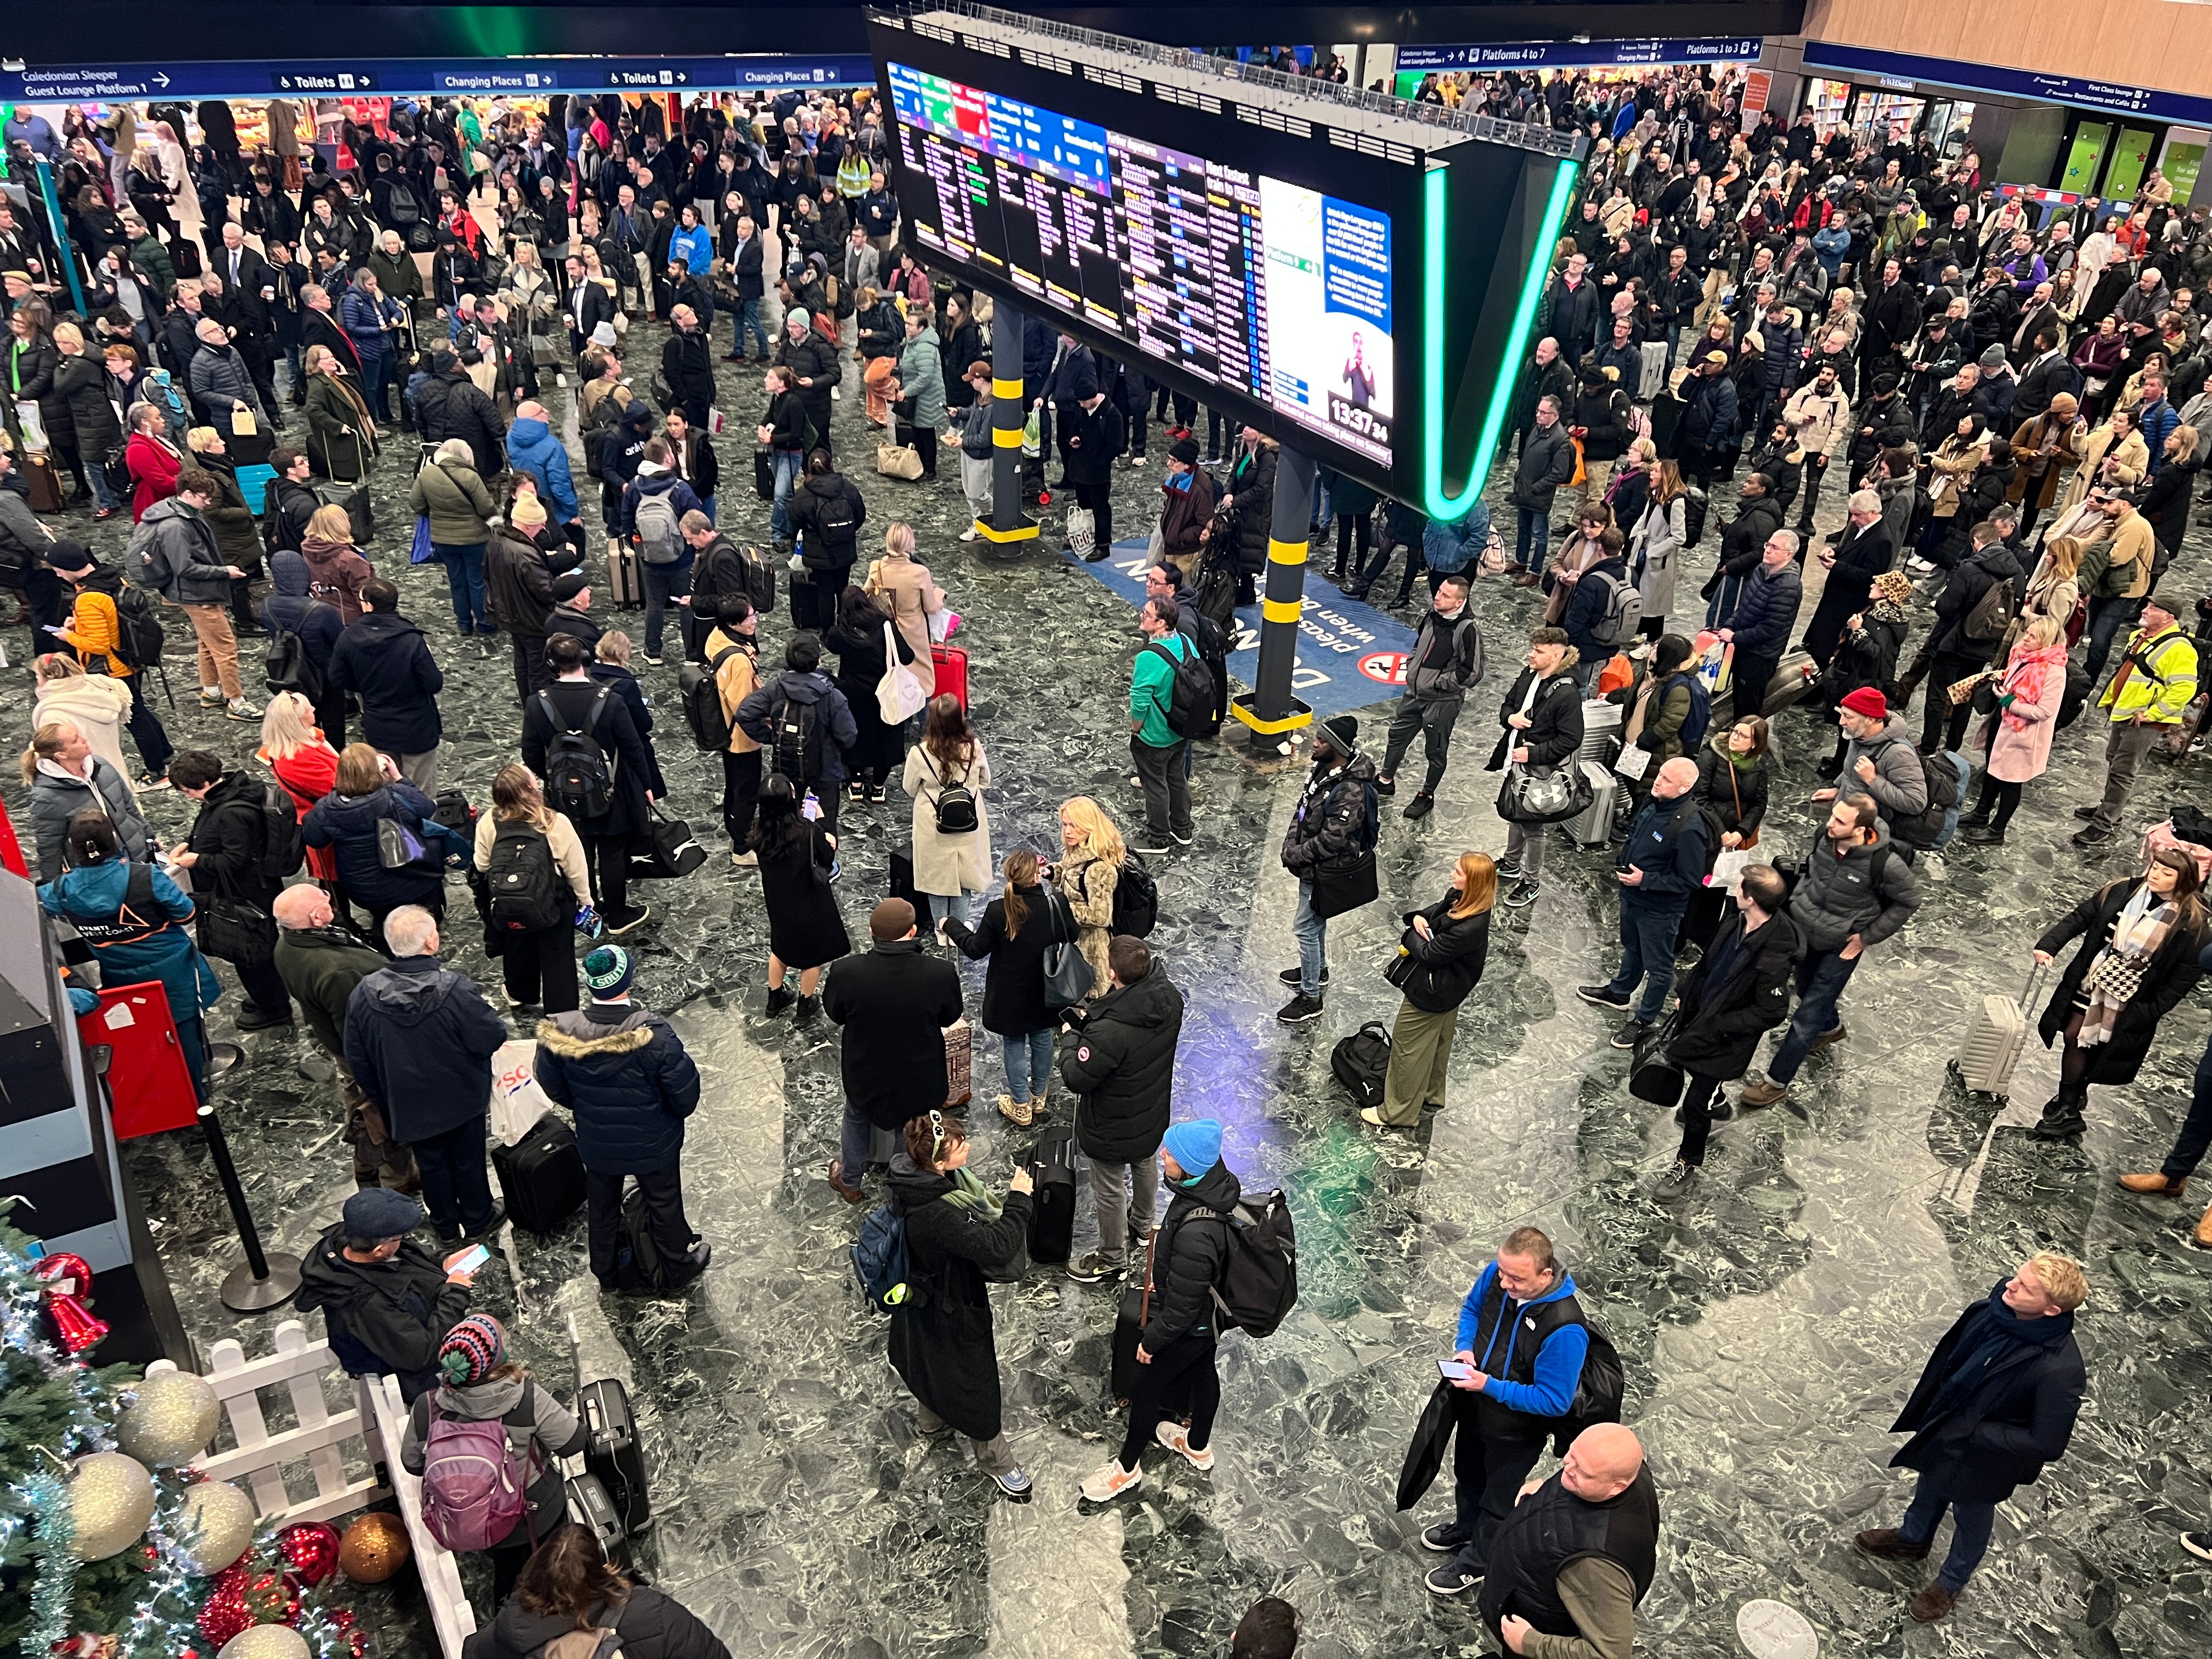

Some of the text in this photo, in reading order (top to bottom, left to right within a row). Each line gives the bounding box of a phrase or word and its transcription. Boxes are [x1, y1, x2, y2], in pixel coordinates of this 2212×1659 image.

[1482, 48, 1545, 60] Platforms 4 to 7
[1686, 44, 1738, 54] Platforms 1 to 3
[21, 70, 118, 82] Caledonian Sleeper
[294, 76, 335, 88] Toilets
[445, 76, 522, 88] Changing Places
[622, 72, 657, 84] Toilets
[745, 71, 810, 83] Changing Places
[25, 83, 147, 97] Guest Lounge Platform 1
[1106, 131, 1158, 160] Further departures
[1205, 160, 1249, 187] Next fastest
[1206, 175, 1233, 196] train to
[1267, 247, 1294, 266] Platform
[1279, 400, 1305, 420] industrial
[1305, 414, 1322, 427] action
[1322, 422, 1340, 438] taking
[1340, 430, 1356, 444] place
[1356, 438, 1365, 448] on
[1331, 399, 1388, 442] 13:37 34
[1297, 615, 1361, 653] pleas
[1317, 610, 1376, 644] when
[105, 926, 134, 935] COAST
